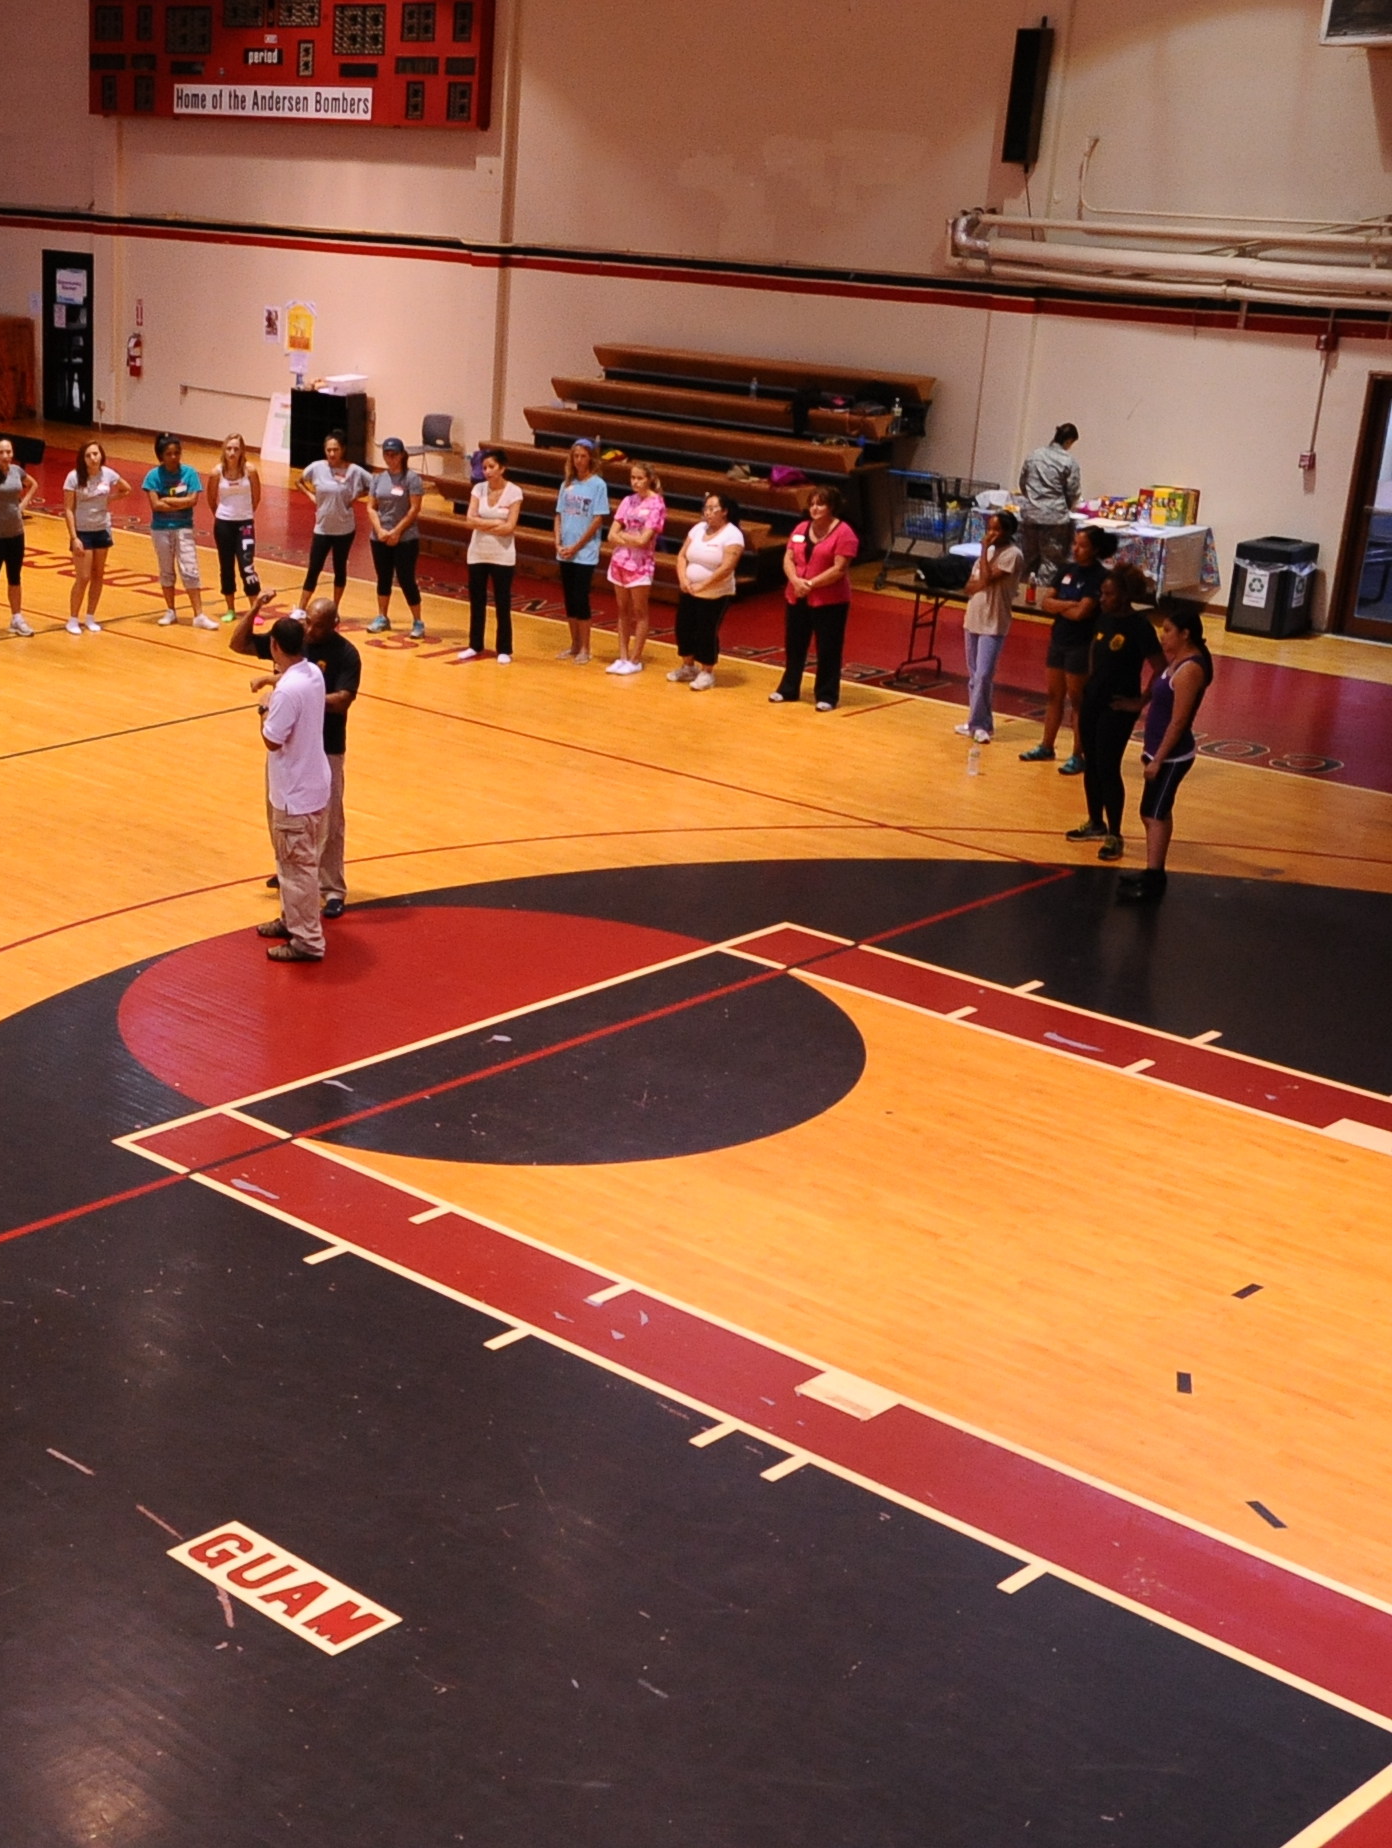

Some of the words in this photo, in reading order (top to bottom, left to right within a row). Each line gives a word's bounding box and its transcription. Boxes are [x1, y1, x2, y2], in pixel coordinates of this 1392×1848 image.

[248, 48, 278, 66] period
[176, 88, 206, 110] Home
[212, 89, 223, 110] of
[228, 90, 246, 111] the
[252, 90, 308, 113] Andersen
[315, 91, 369, 115] Bombers
[187, 1532, 386, 1646] GUAM
